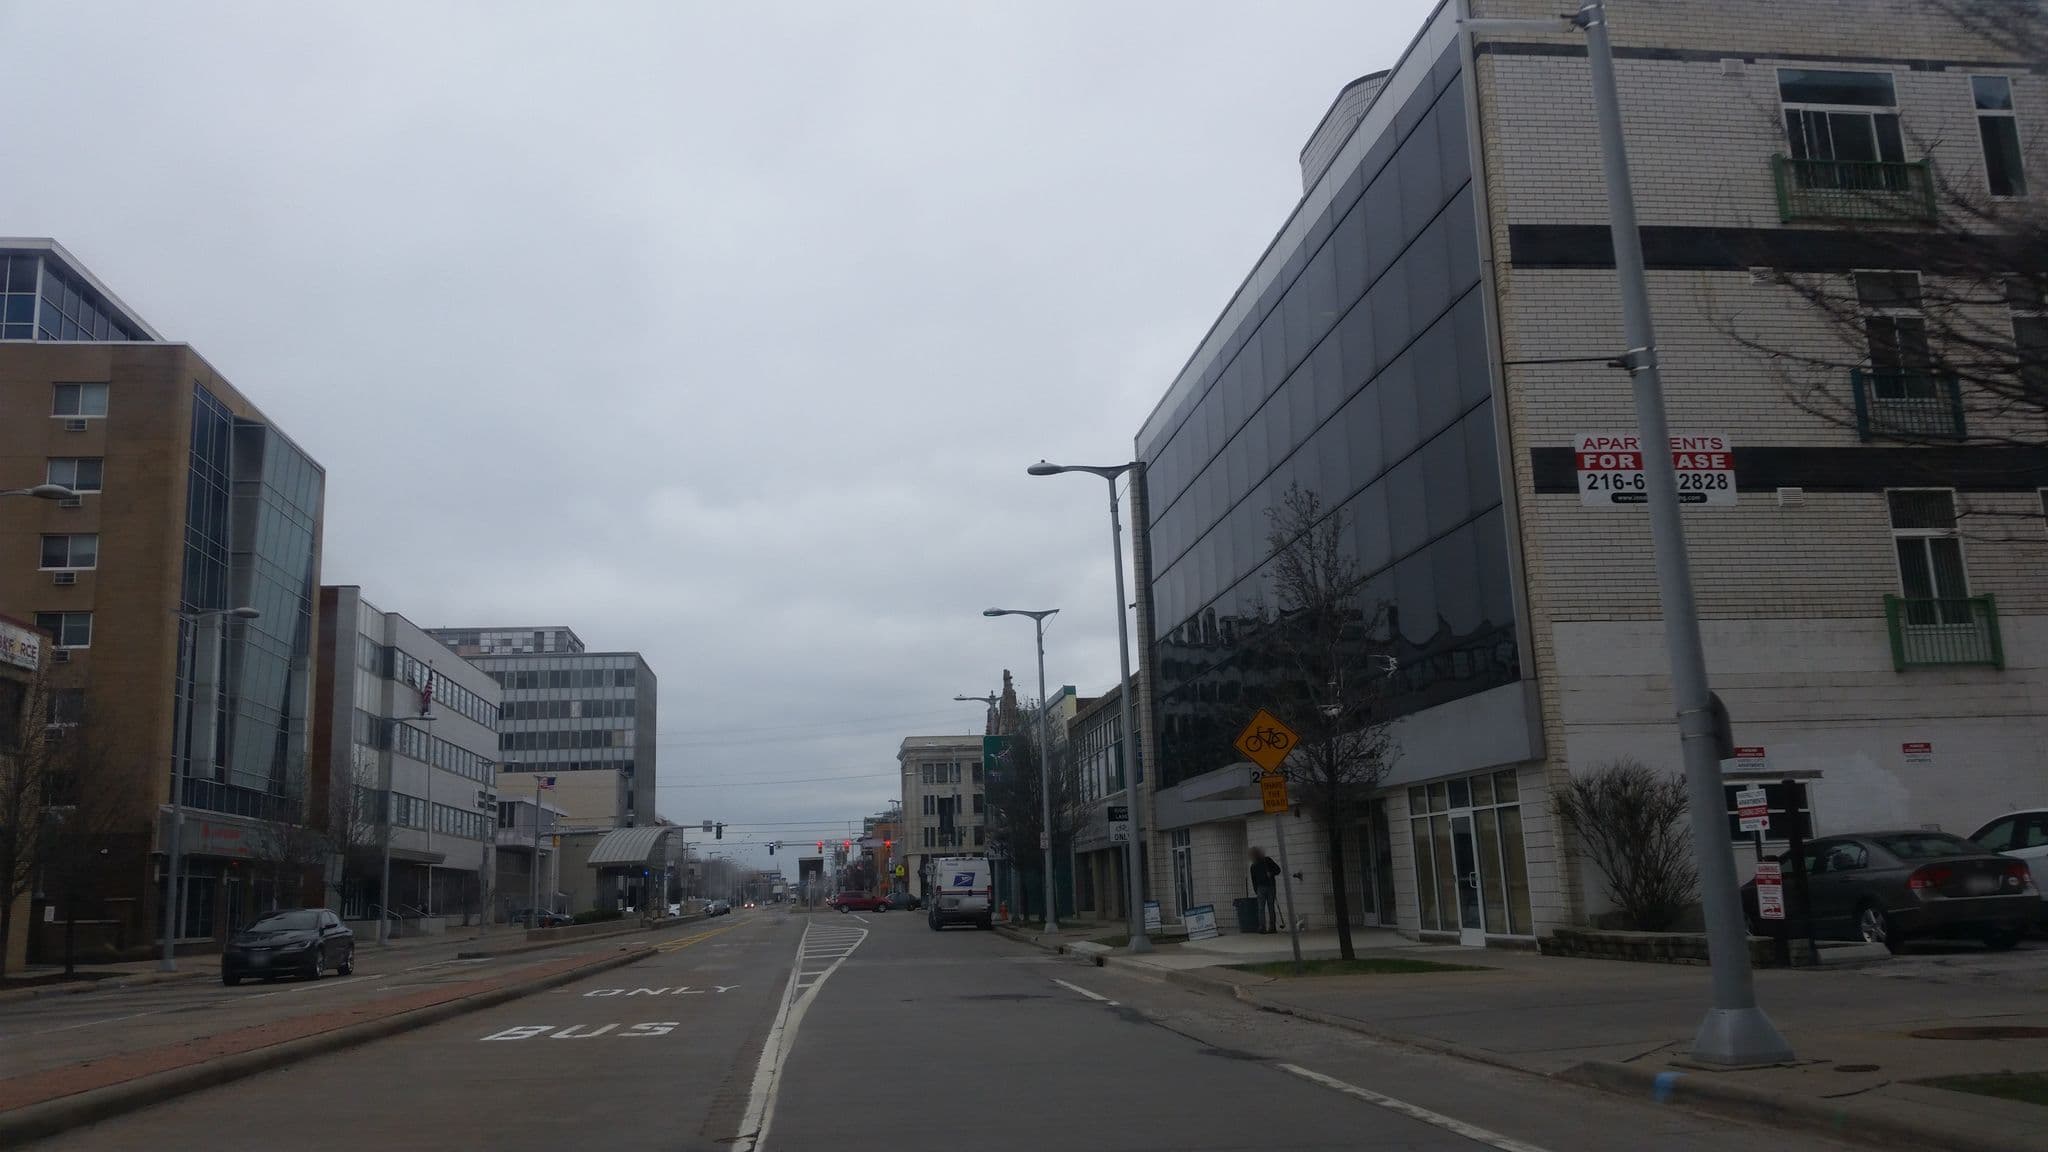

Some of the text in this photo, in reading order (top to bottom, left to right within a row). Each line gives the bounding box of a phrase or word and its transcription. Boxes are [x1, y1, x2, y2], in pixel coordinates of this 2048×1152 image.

[1583, 437, 1723, 450] APARENTS
[1583, 454, 1727, 469] FOR ASE
[582, 984, 742, 997] ONLY
[479, 1021, 681, 1041] BUS
